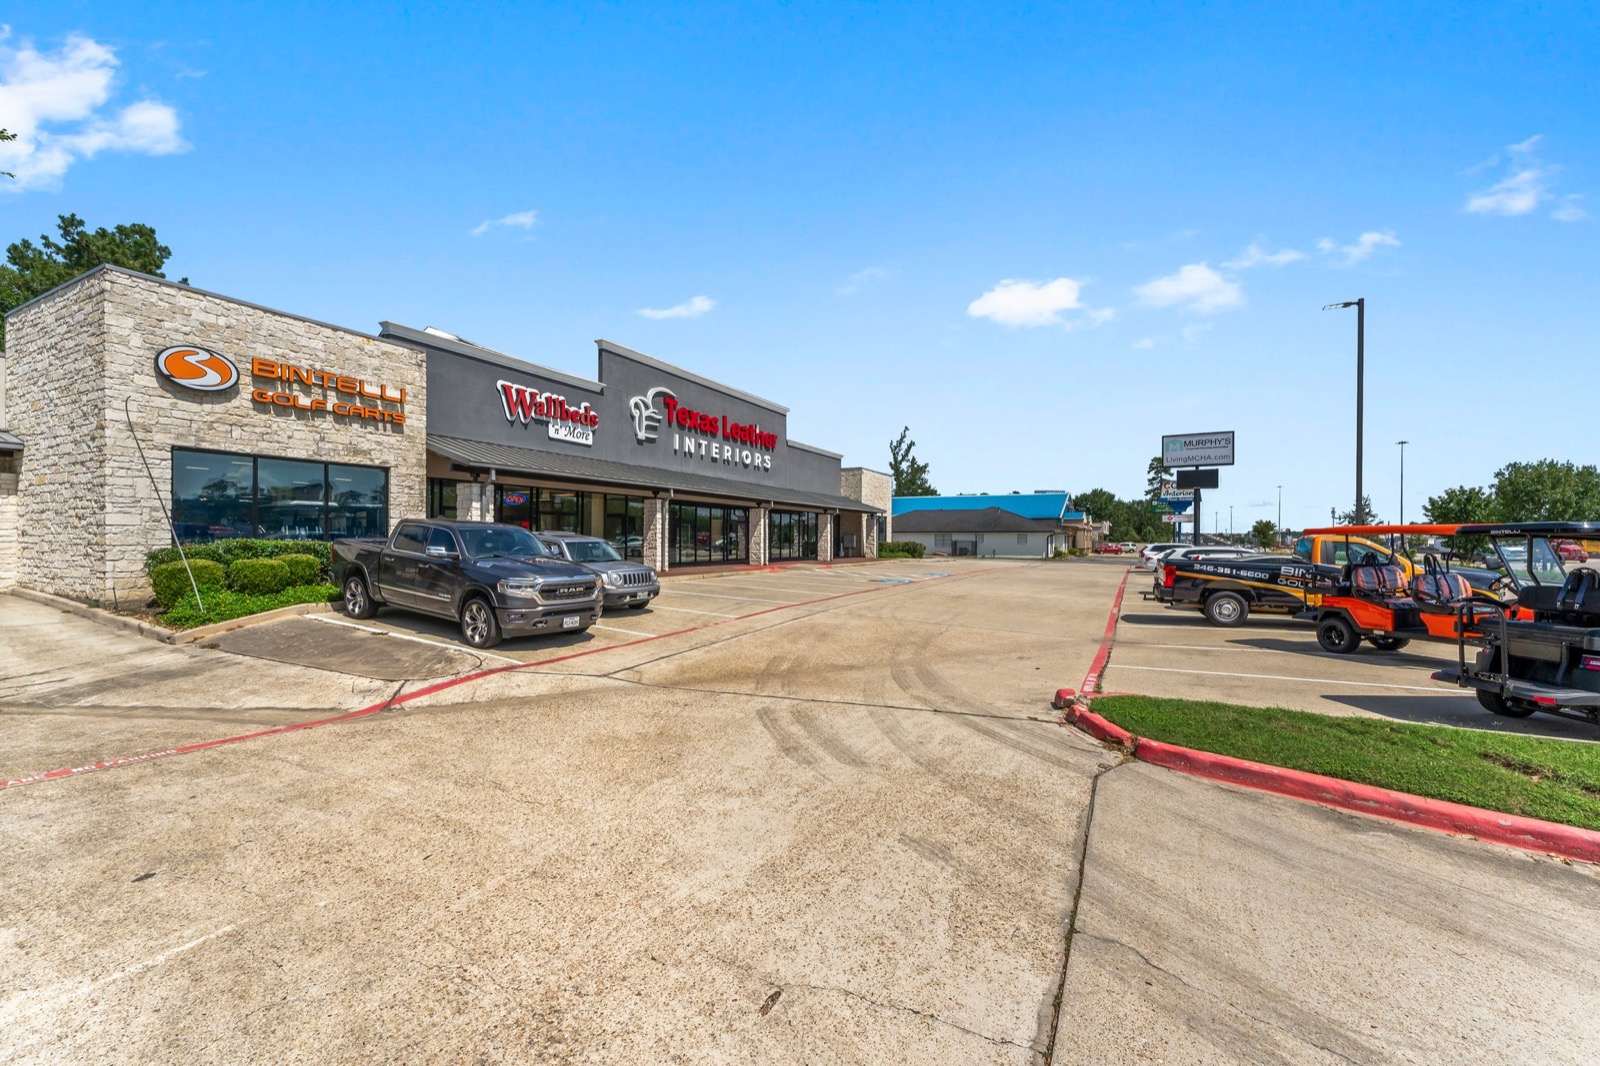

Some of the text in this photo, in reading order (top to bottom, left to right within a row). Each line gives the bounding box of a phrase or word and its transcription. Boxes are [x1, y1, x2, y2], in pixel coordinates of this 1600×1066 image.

[252, 358, 406, 403] BINTELLI
[252, 389, 406, 424] GOLF CARTS
[499, 382, 599, 428] Wallbeds
[564, 426, 590, 441] More
[663, 396, 779, 450] Texas Leather
[673, 433, 772, 469] INTERIORS
[1184, 437, 1231, 448] MURPHY'S
[507, 495, 524, 503] OPEN
[1278, 577, 1312, 589] GOL
